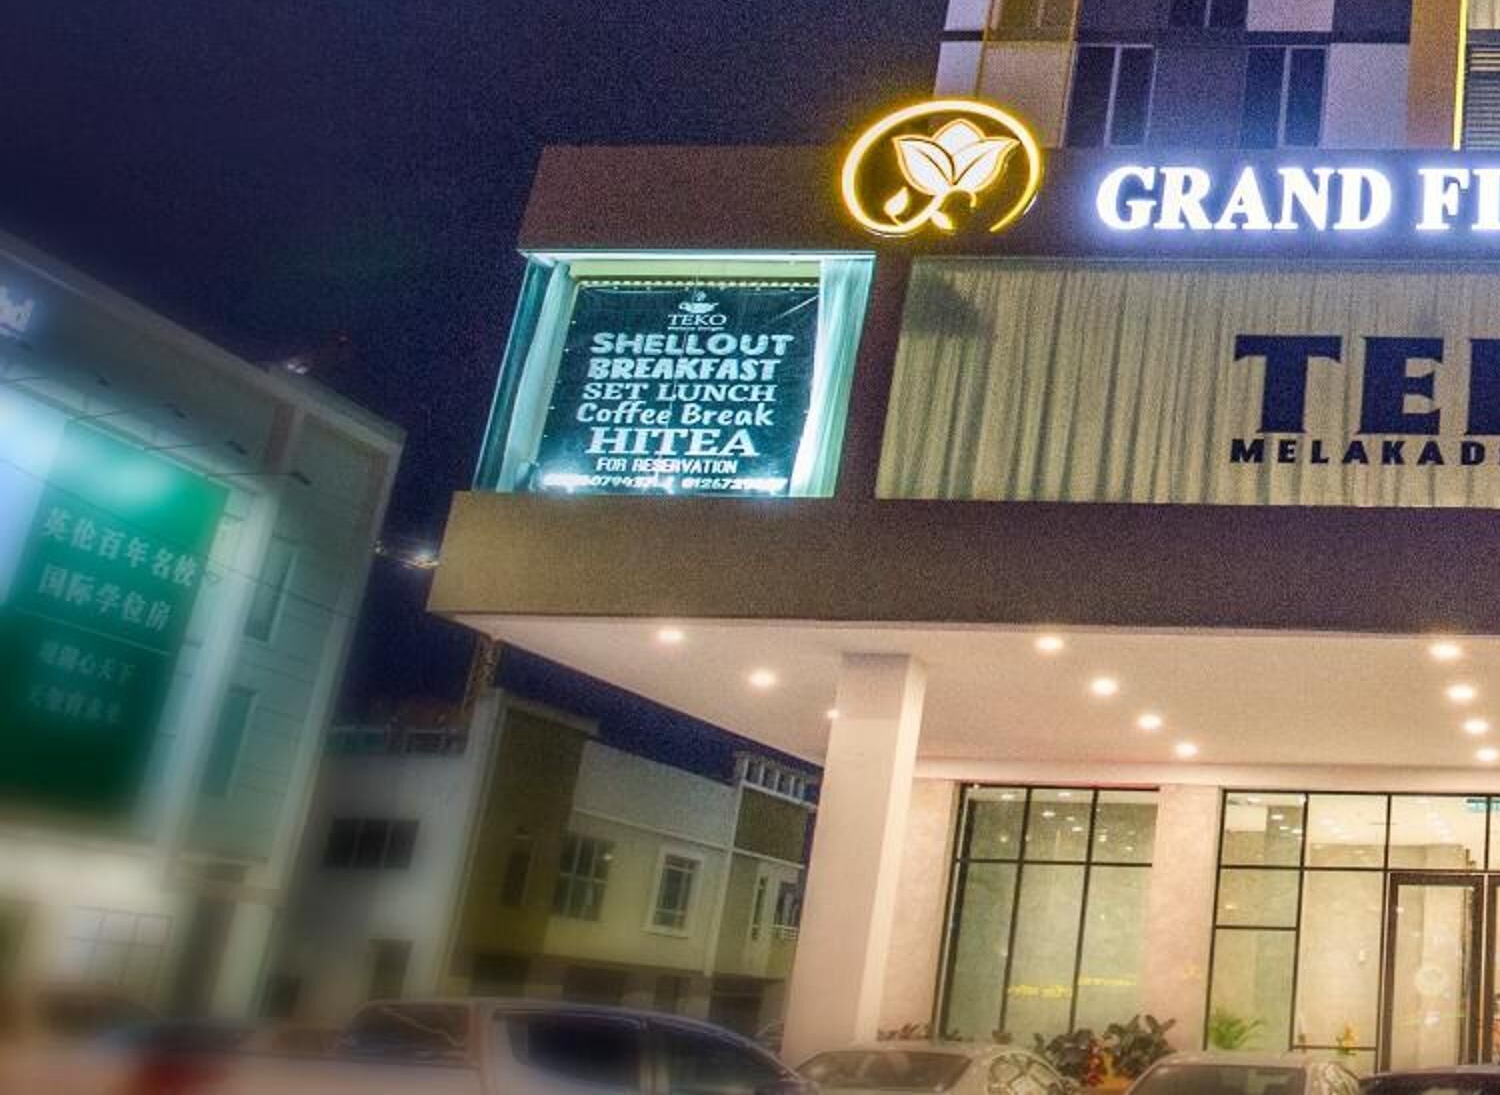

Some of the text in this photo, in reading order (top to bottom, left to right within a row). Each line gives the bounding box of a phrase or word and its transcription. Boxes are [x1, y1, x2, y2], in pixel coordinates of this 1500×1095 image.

[1096, 166, 1392, 230] GRAND
[667, 313, 728, 327] TEKO
[586, 357, 782, 381] BREAKFAST
[582, 382, 778, 403] SET LUNCH
[576, 400, 775, 426] Coffee Break
[584, 426, 761, 457] HITEA
[596, 457, 738, 474] FOR RESERVATION
